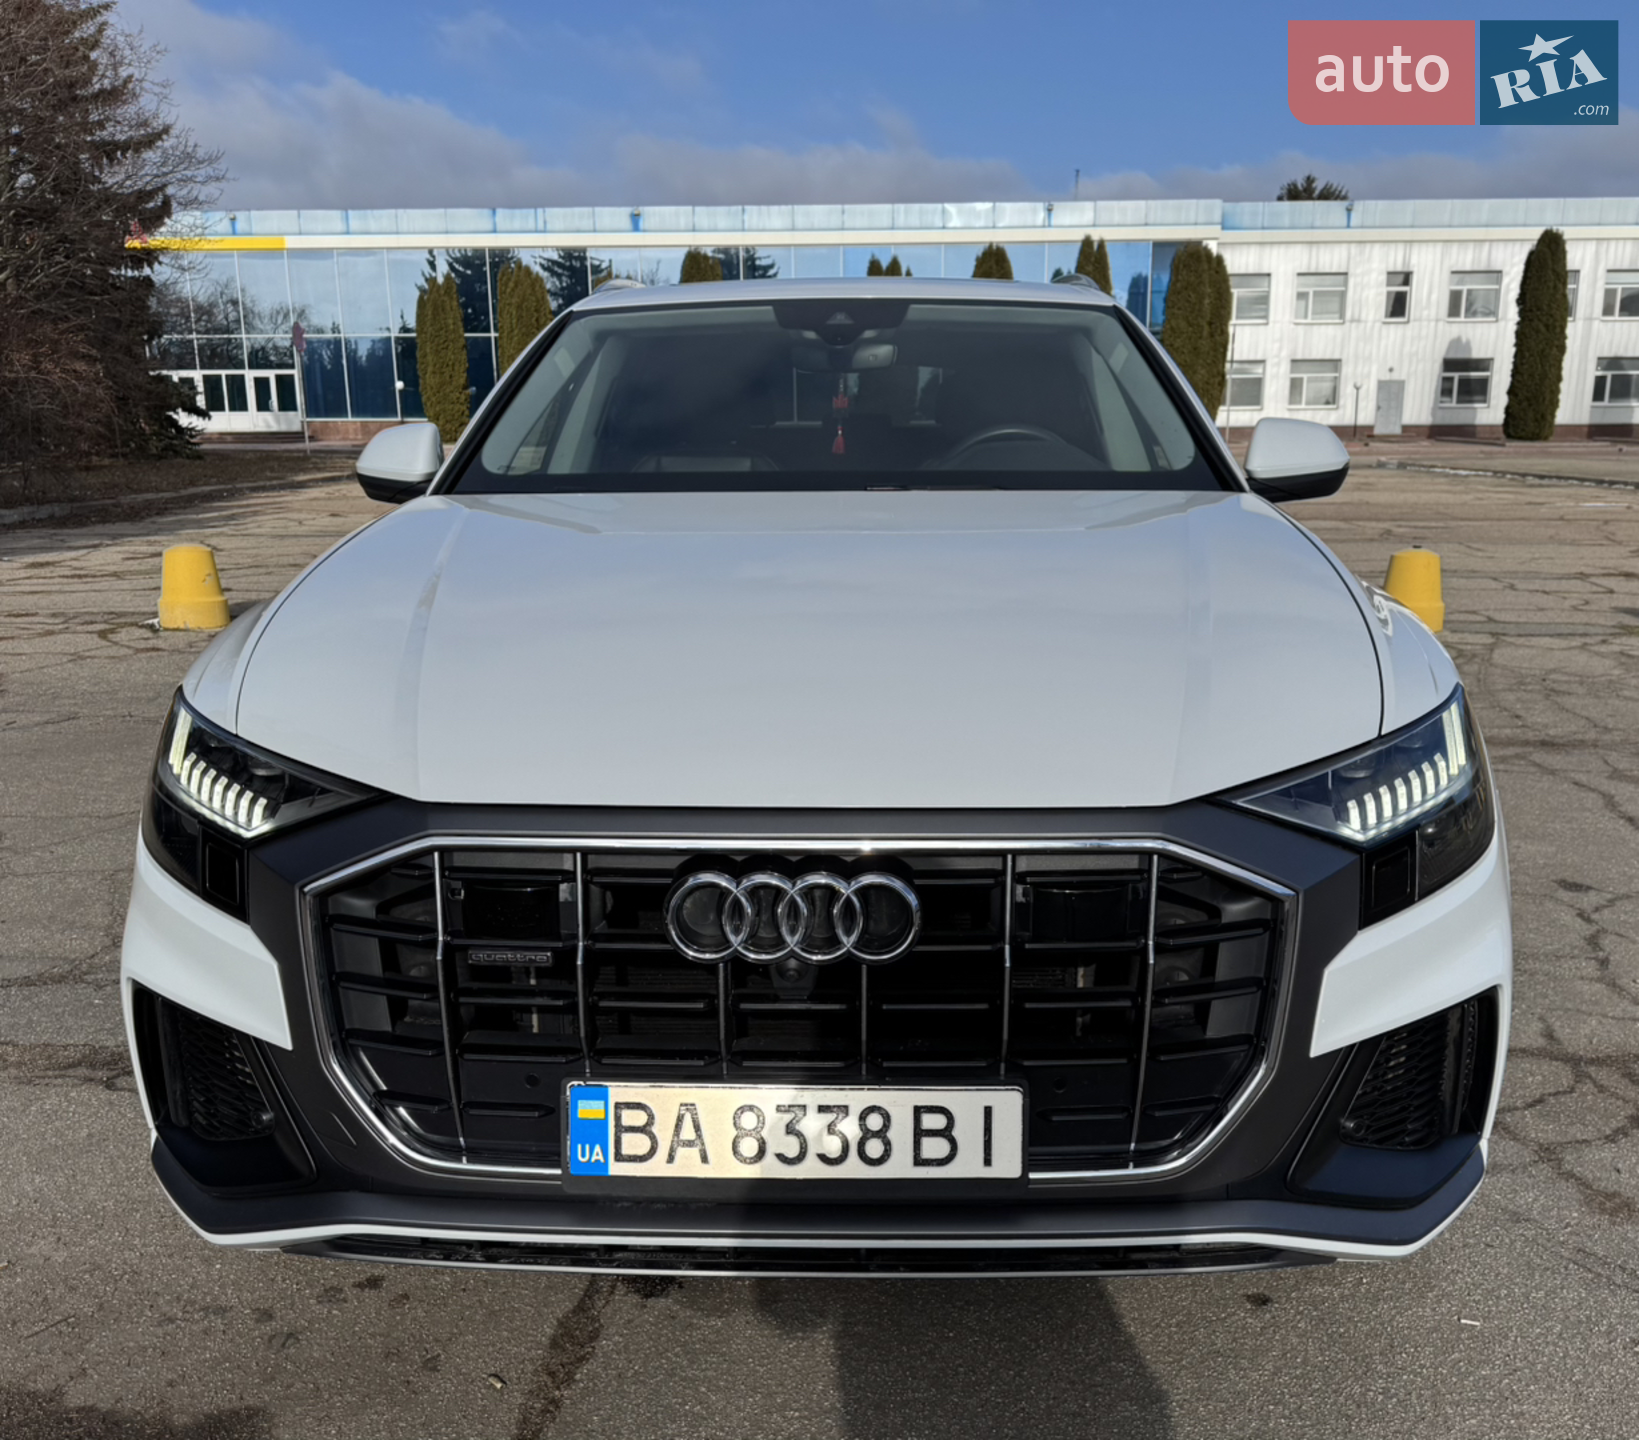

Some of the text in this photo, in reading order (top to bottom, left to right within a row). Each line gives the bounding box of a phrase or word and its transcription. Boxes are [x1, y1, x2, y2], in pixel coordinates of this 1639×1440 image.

[471, 953, 548, 962] quattro
[613, 1102, 993, 1168] BA 8338 BI
[577, 1144, 605, 1163] UA
